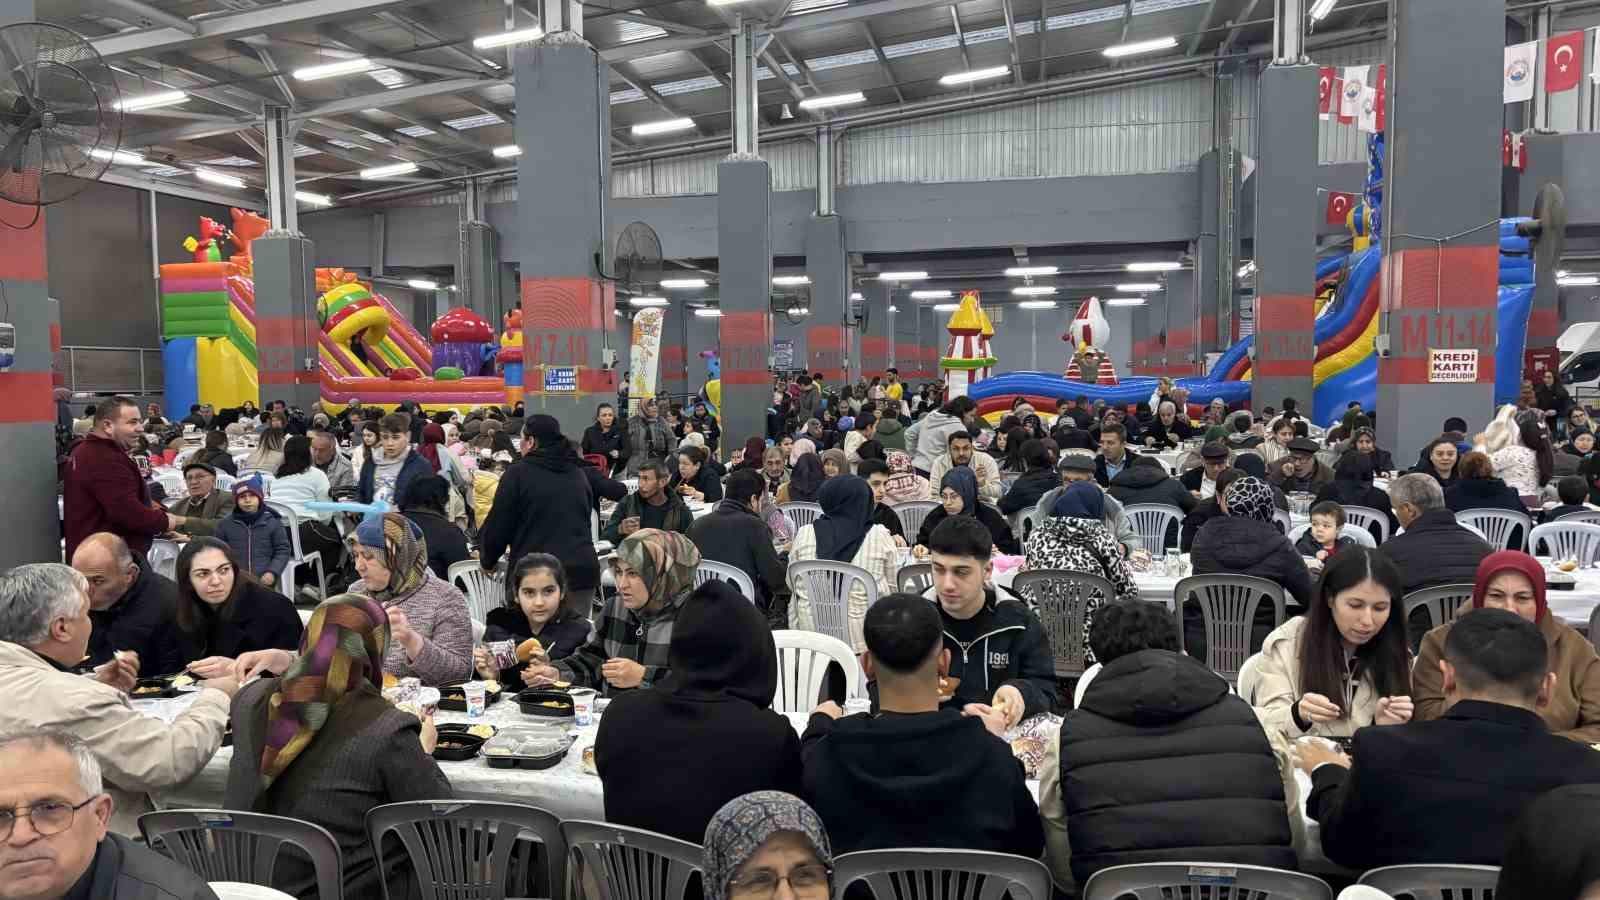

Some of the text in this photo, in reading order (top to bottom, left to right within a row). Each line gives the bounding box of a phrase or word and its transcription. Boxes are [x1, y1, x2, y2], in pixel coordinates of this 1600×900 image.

[1401, 314, 1428, 352] M
[1433, 352, 1475, 361] KREDİ
[1433, 363, 1474, 371] KARTI
